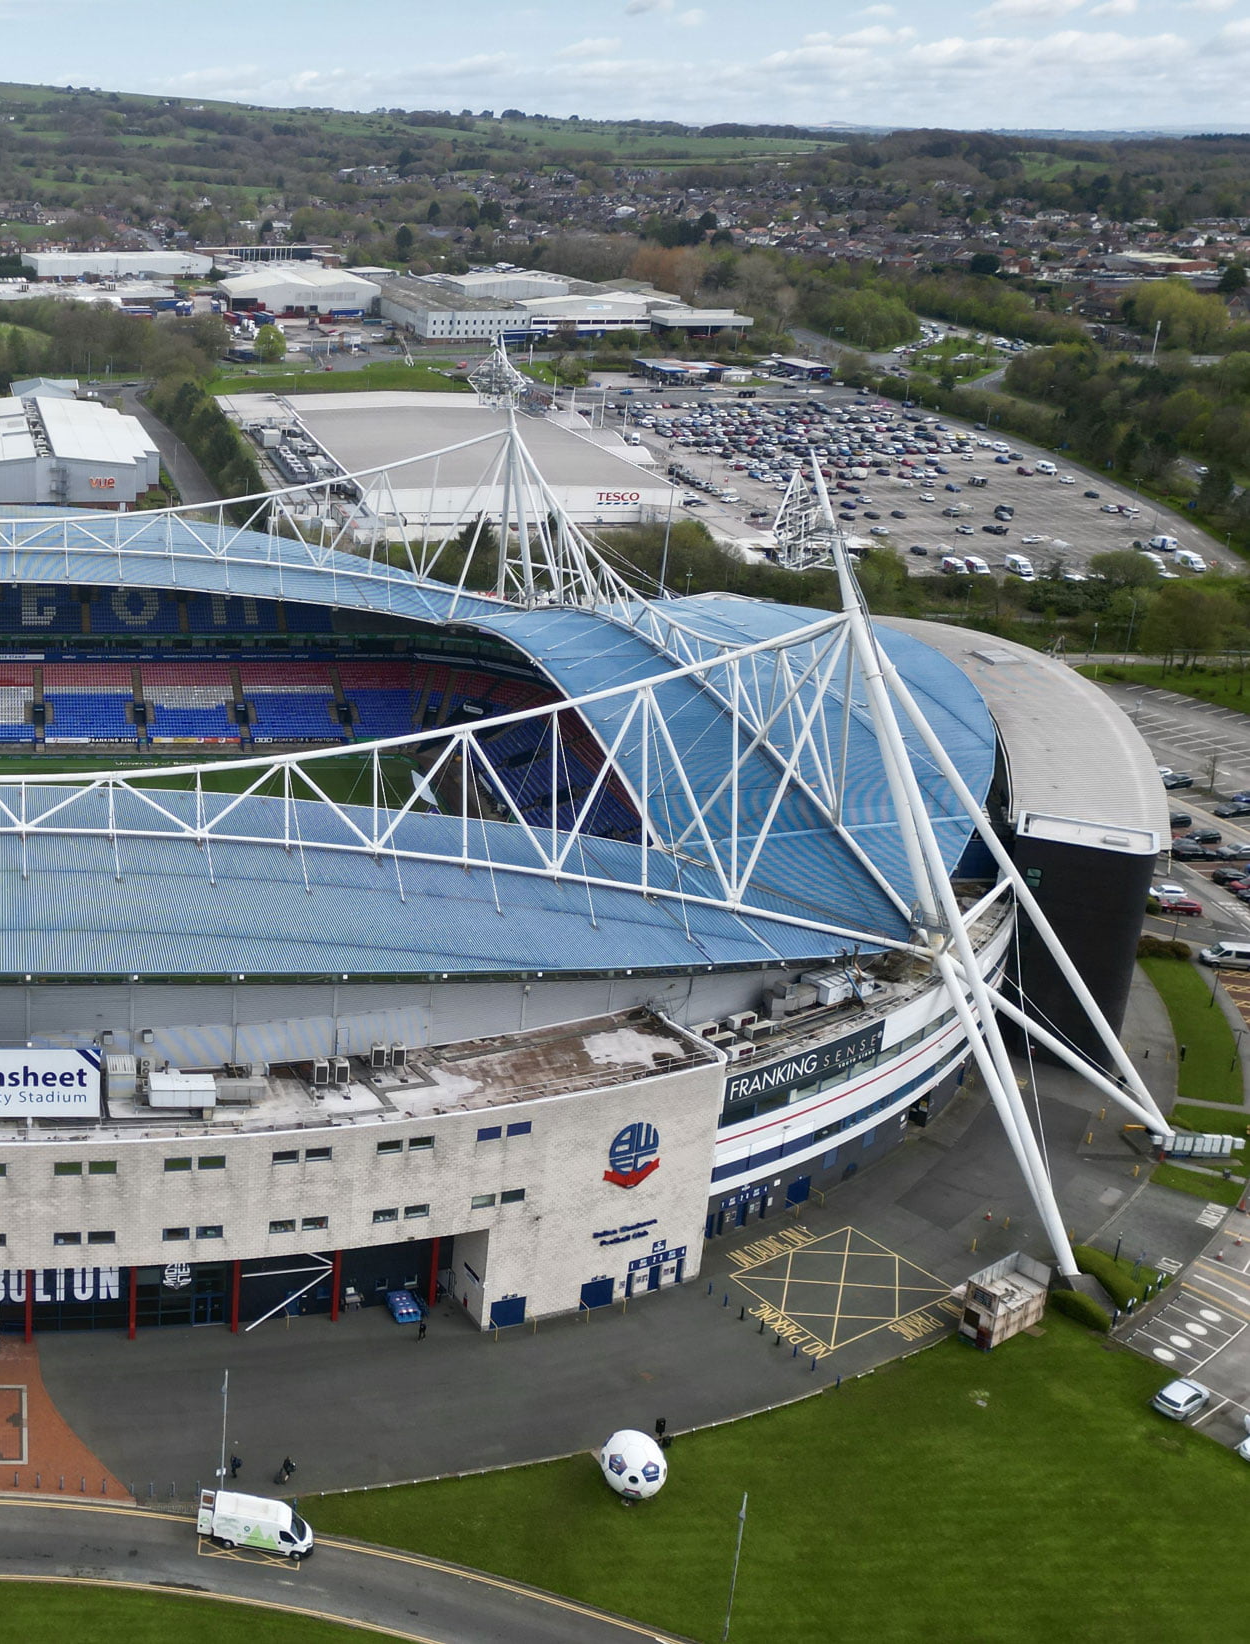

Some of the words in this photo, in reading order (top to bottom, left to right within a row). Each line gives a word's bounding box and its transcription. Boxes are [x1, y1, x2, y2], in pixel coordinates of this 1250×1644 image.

[89, 476, 115, 488] vue
[596, 492, 640, 501] TESCO
[729, 1055, 817, 1100] FRANKING
[823, 1034, 877, 1067] SENSE
[19, 1091, 87, 1104] Stadium
[726, 1235, 792, 1268] UNLOADING
[779, 1224, 817, 1246] ONLY
[748, 1303, 805, 1345] PARKING
[888, 1310, 945, 1342] PARKING
[802, 1339, 833, 1360] NO
